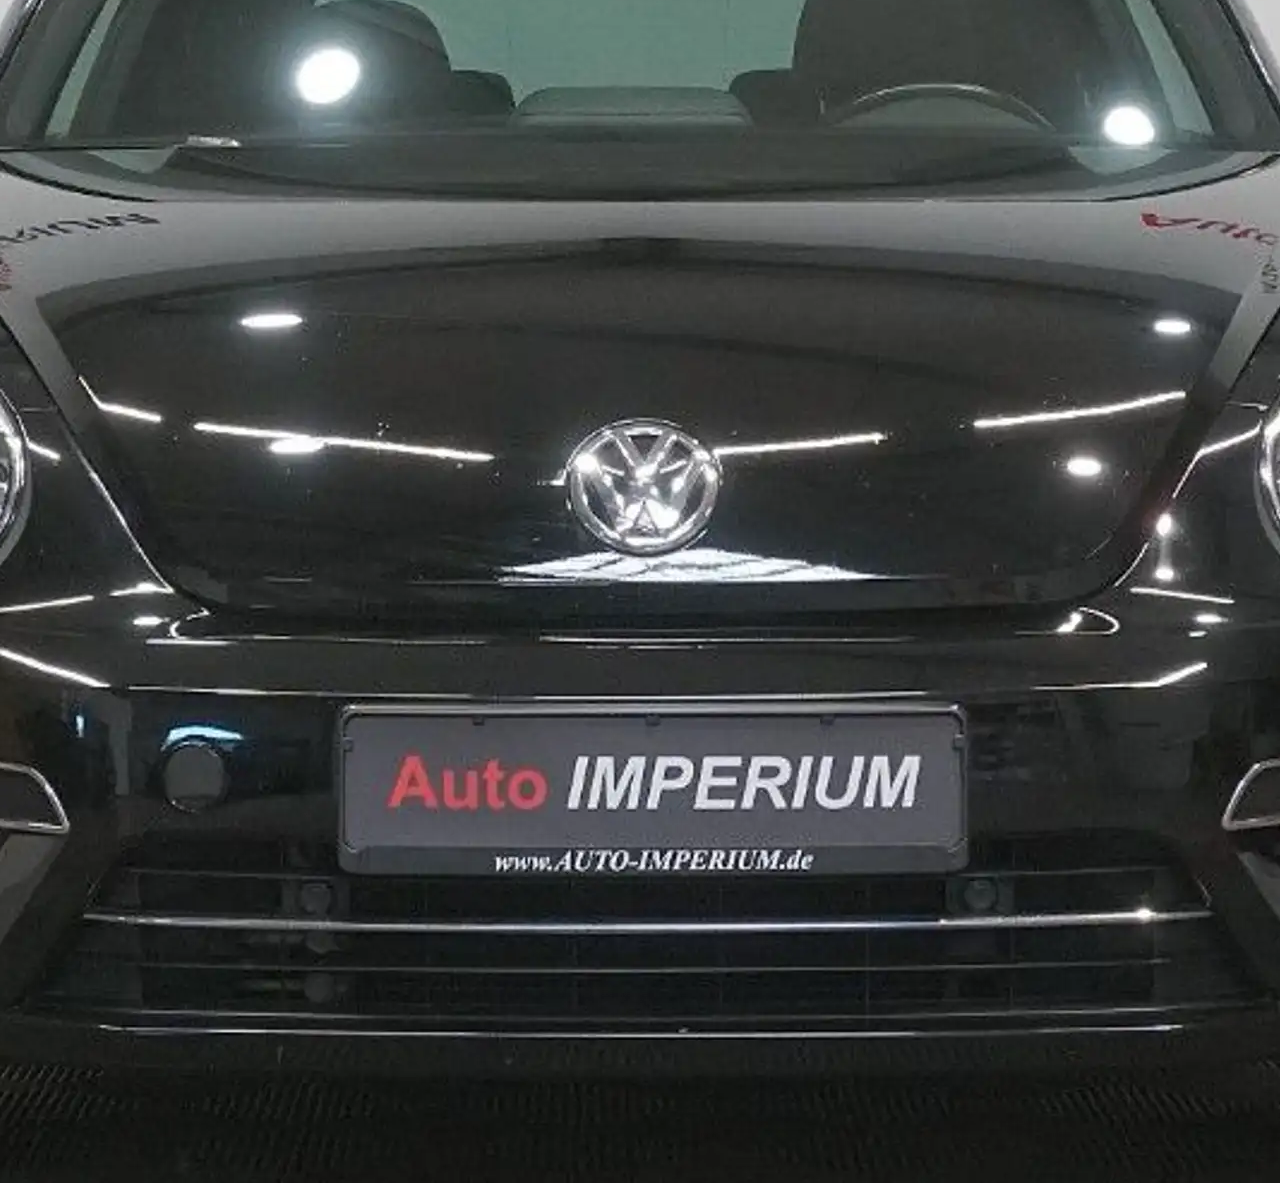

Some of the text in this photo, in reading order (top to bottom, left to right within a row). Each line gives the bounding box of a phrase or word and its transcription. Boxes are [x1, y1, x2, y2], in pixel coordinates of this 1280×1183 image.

[388, 754, 921, 811] Auto IMPERIUM
[495, 849, 815, 873] www.AUTO-IMPERIUM.de
